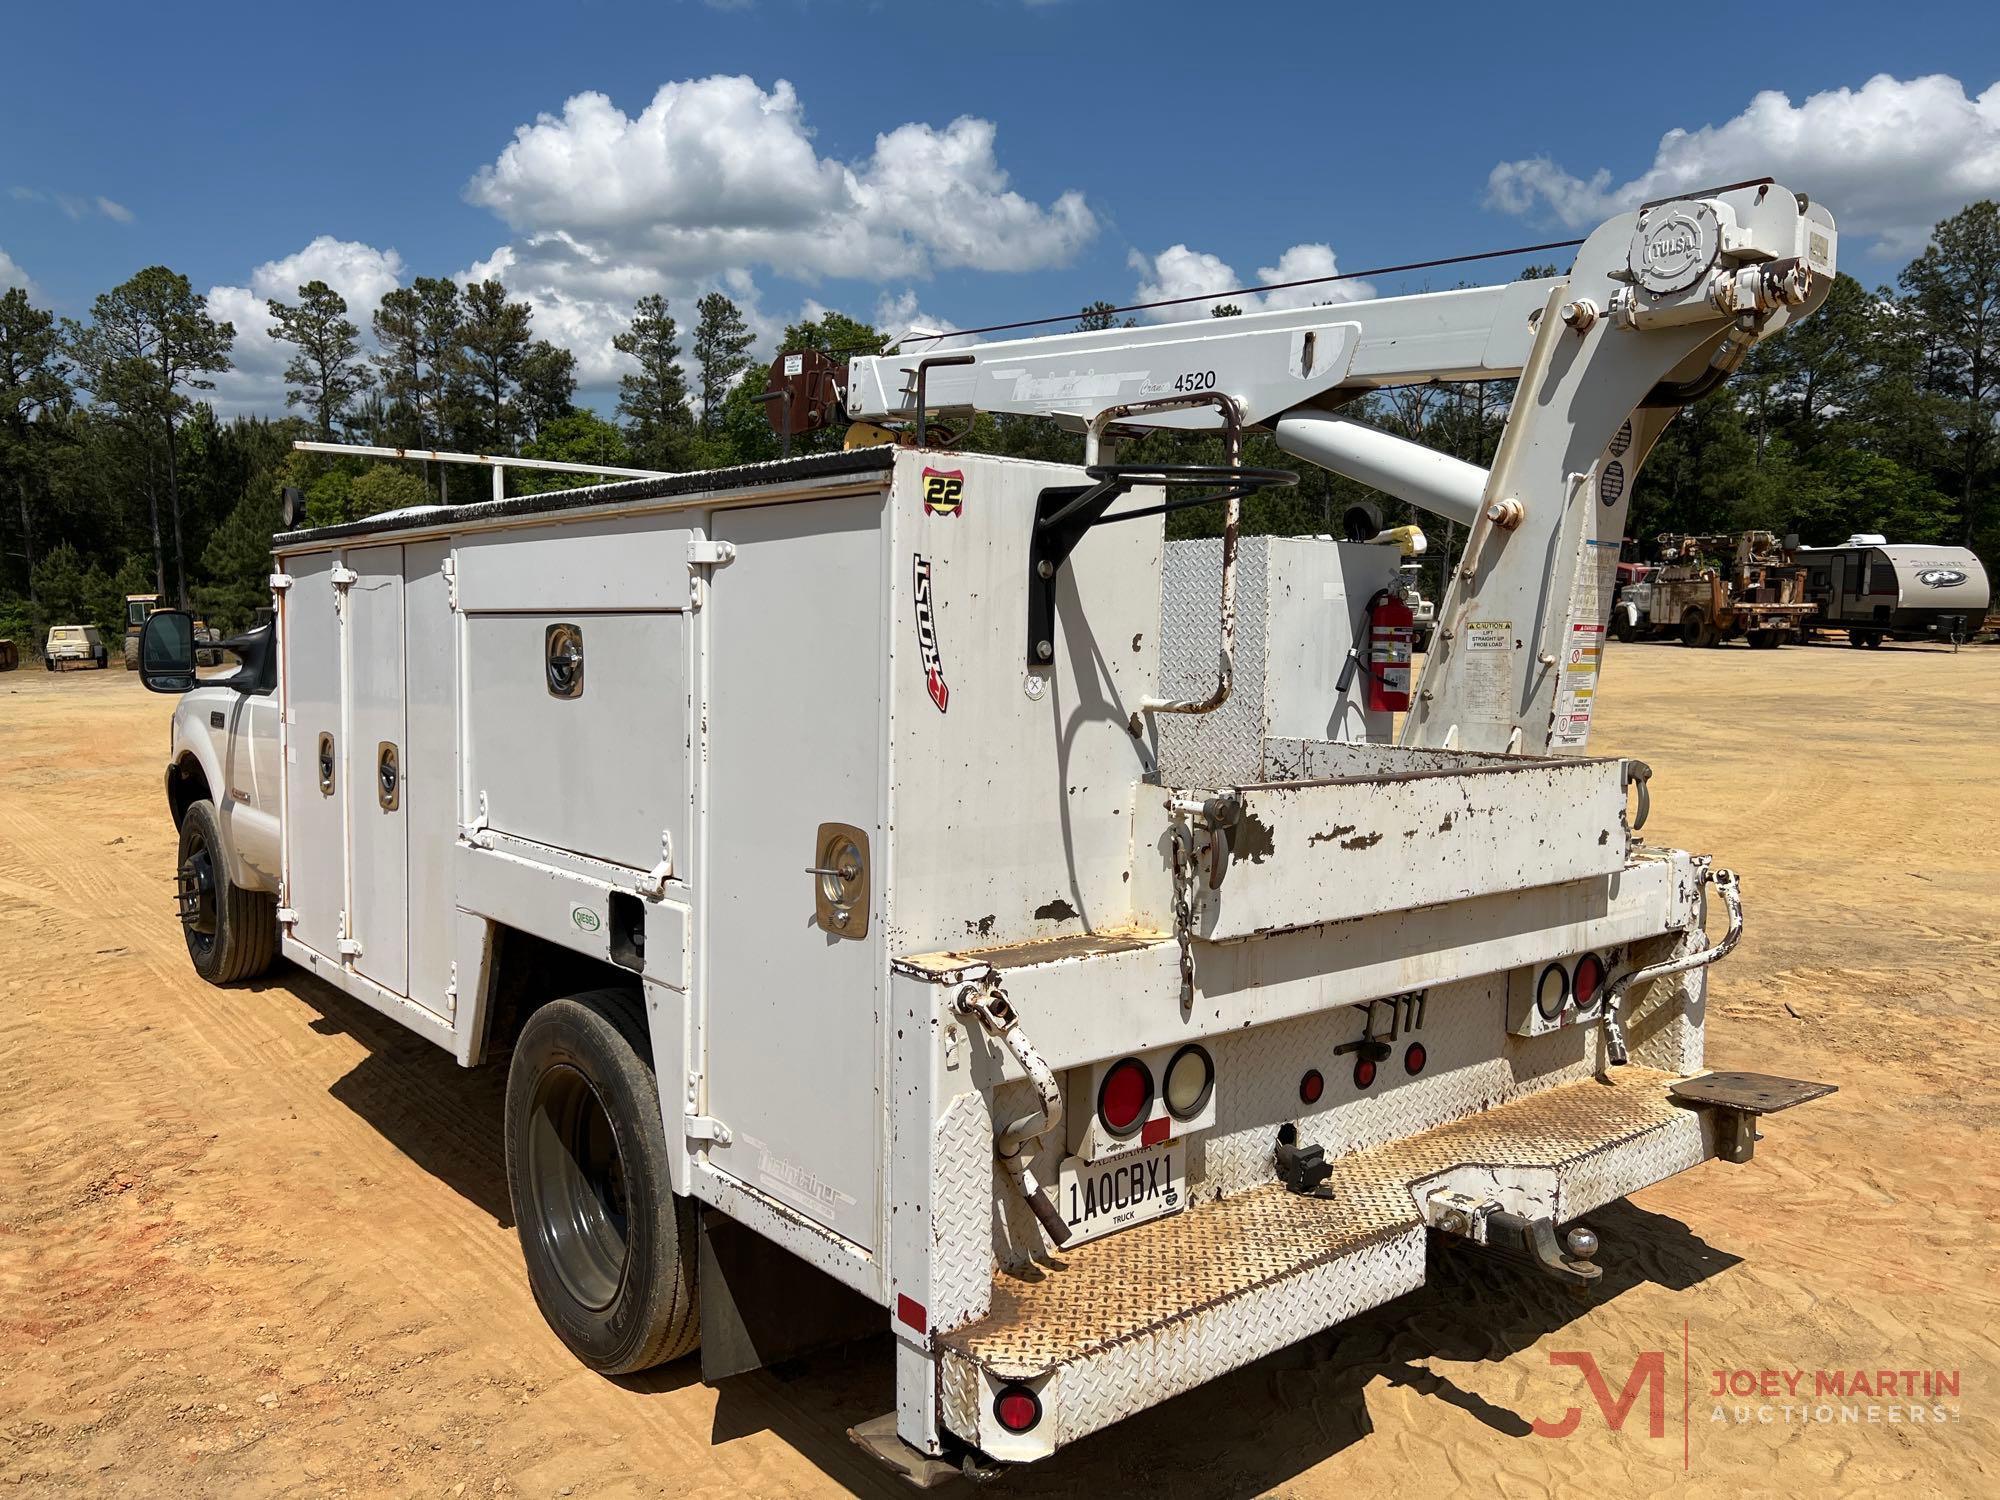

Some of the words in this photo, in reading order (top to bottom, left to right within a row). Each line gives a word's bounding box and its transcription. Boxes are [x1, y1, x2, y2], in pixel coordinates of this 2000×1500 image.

[1652, 235, 1694, 258] TULSA
[1174, 370, 1216, 392] 4520
[926, 478, 962, 505] 22
[576, 911, 596, 927] DIESEL
[1112, 1210, 1135, 1225] TRUCK
